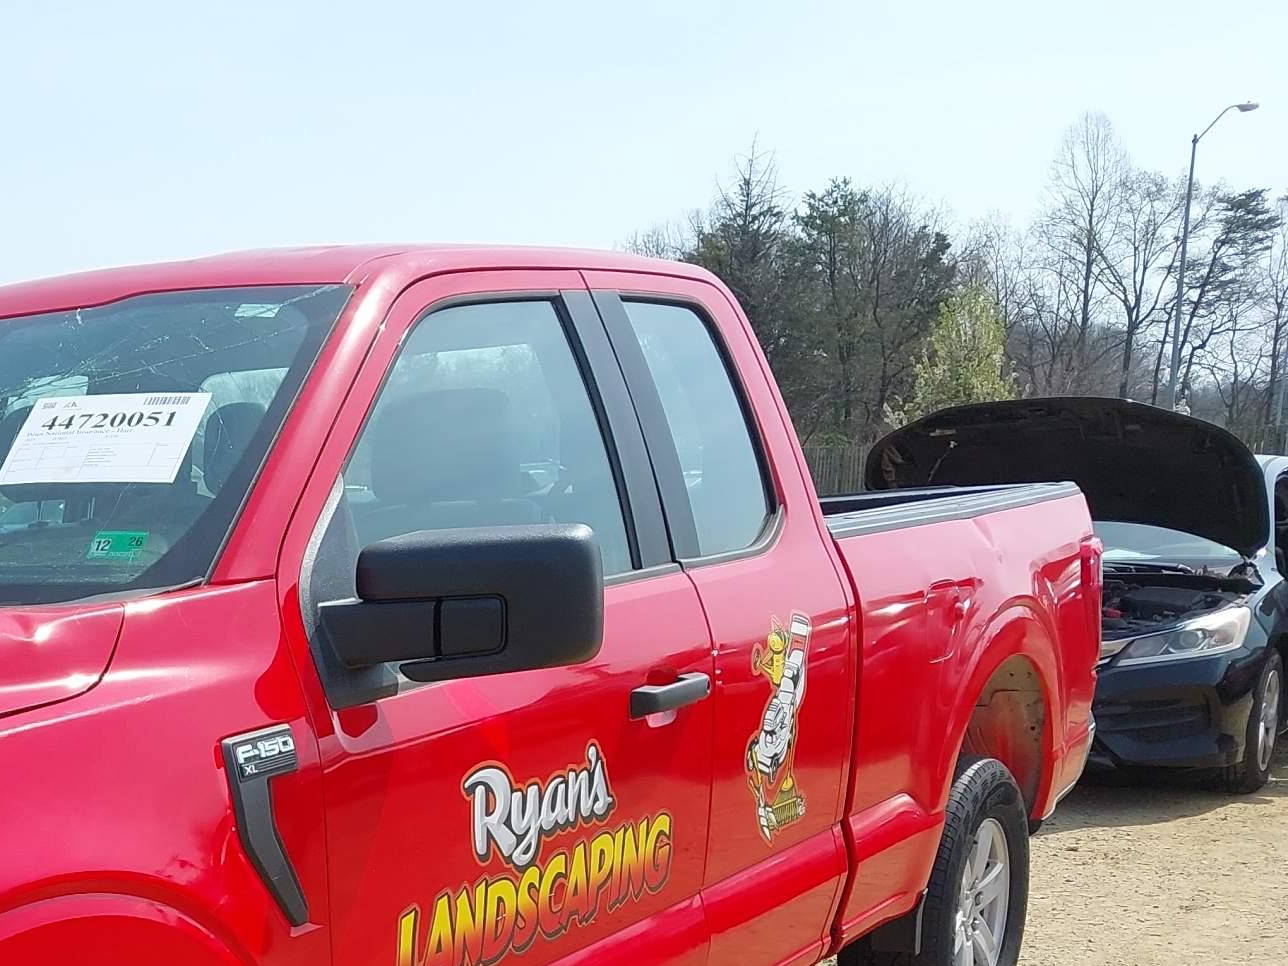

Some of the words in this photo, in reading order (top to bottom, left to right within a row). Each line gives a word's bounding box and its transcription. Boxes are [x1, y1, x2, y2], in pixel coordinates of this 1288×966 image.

[41, 411, 176, 430] 44720051
[95, 539, 111, 551] 12
[128, 536, 144, 547] 26
[236, 735, 295, 764] F-150
[244, 764, 259, 777] XL
[463, 744, 614, 867] Ryan's
